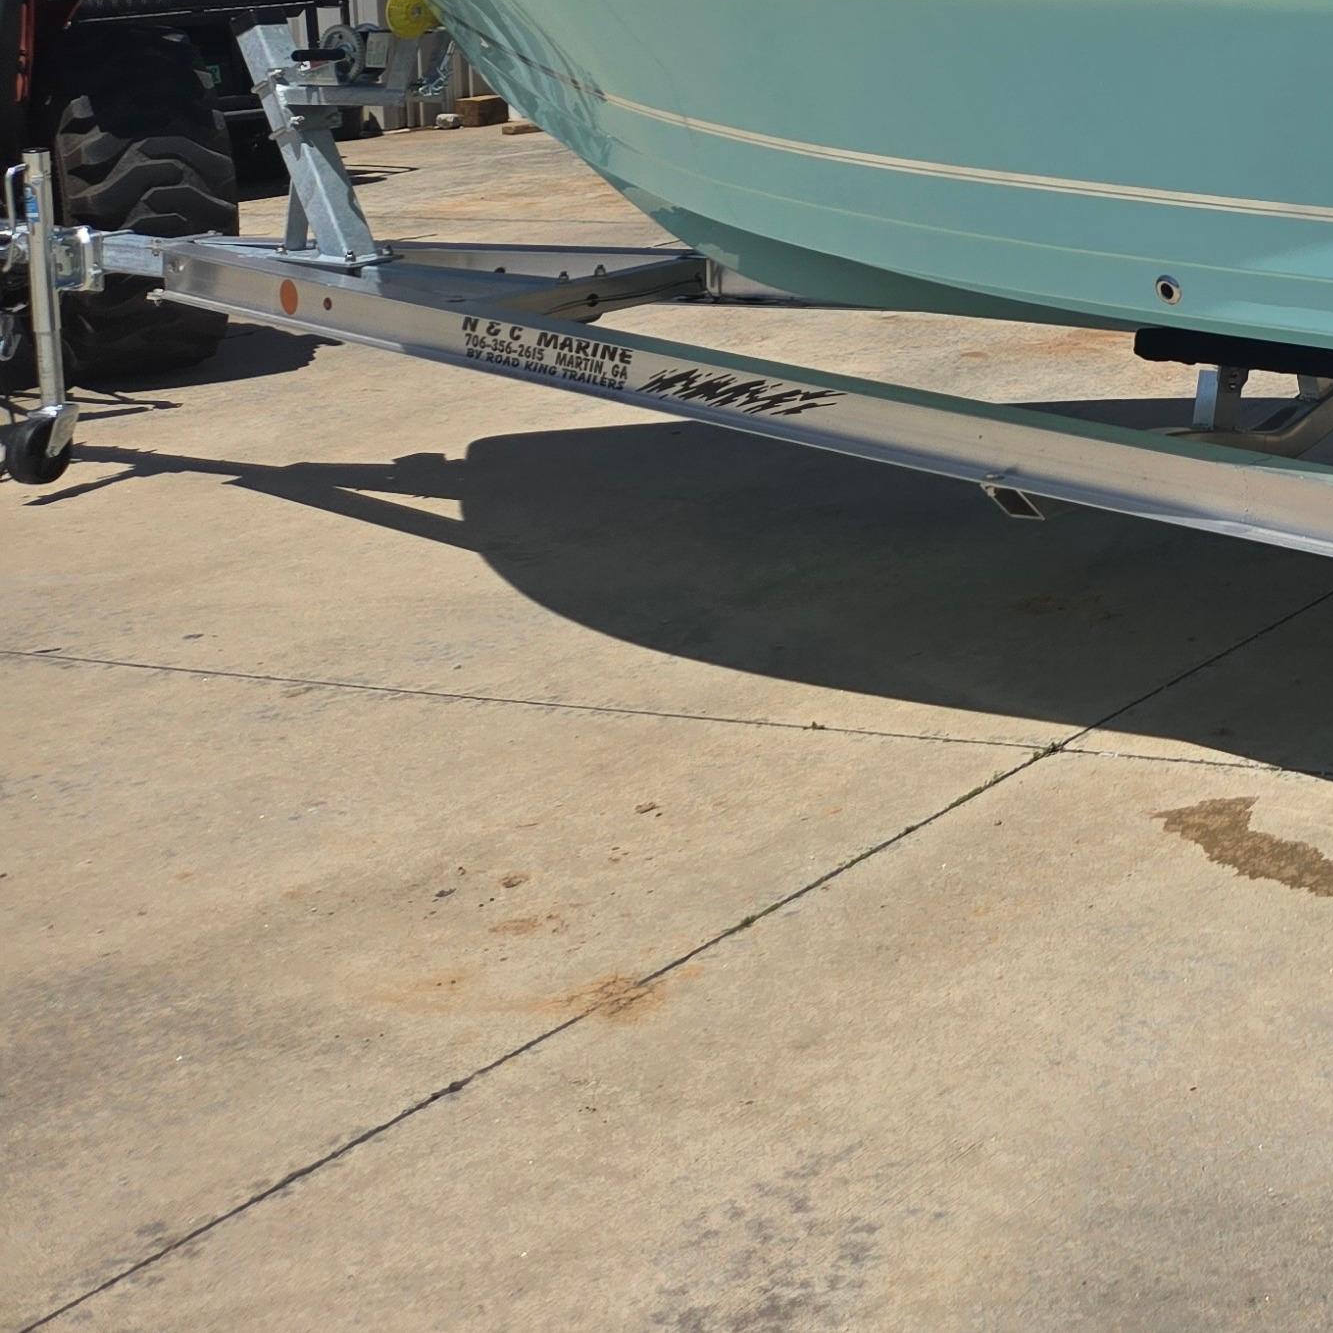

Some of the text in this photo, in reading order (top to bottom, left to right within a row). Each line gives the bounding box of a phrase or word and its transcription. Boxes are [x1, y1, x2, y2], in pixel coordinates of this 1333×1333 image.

[462, 316, 634, 365] N & C MARINE
[464, 333, 545, 362] 706-356-2615
[611, 364, 628, 380] GA
[466, 348, 626, 390] BY ROAD KING TRAILERS
